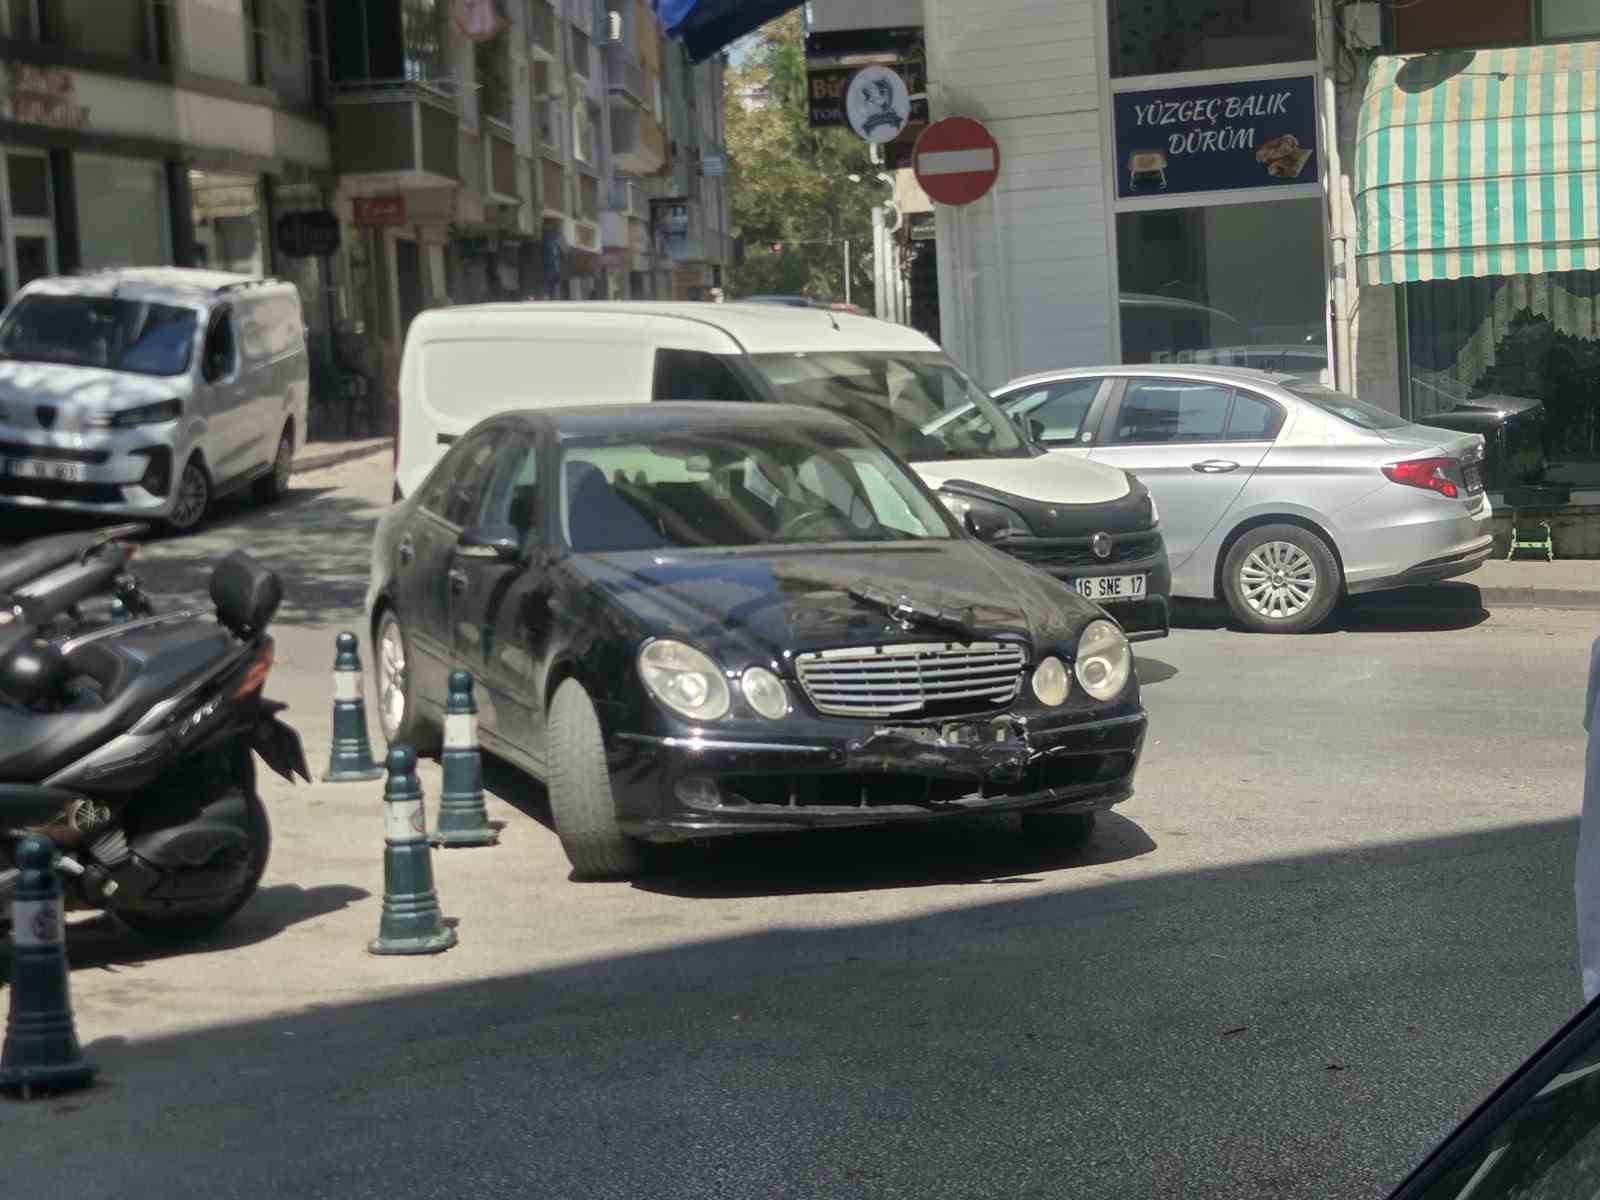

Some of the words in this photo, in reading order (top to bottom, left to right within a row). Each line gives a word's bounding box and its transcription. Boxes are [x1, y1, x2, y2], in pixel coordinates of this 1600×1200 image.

[1134, 97, 1220, 125] YÜZGEÇ
[1225, 92, 1292, 116] BALIK
[1168, 126, 1254, 154] DÜRÜM
[1079, 579, 1092, 597] 16
[1099, 577, 1121, 596] SNE
[1131, 576, 1143, 594] 17
